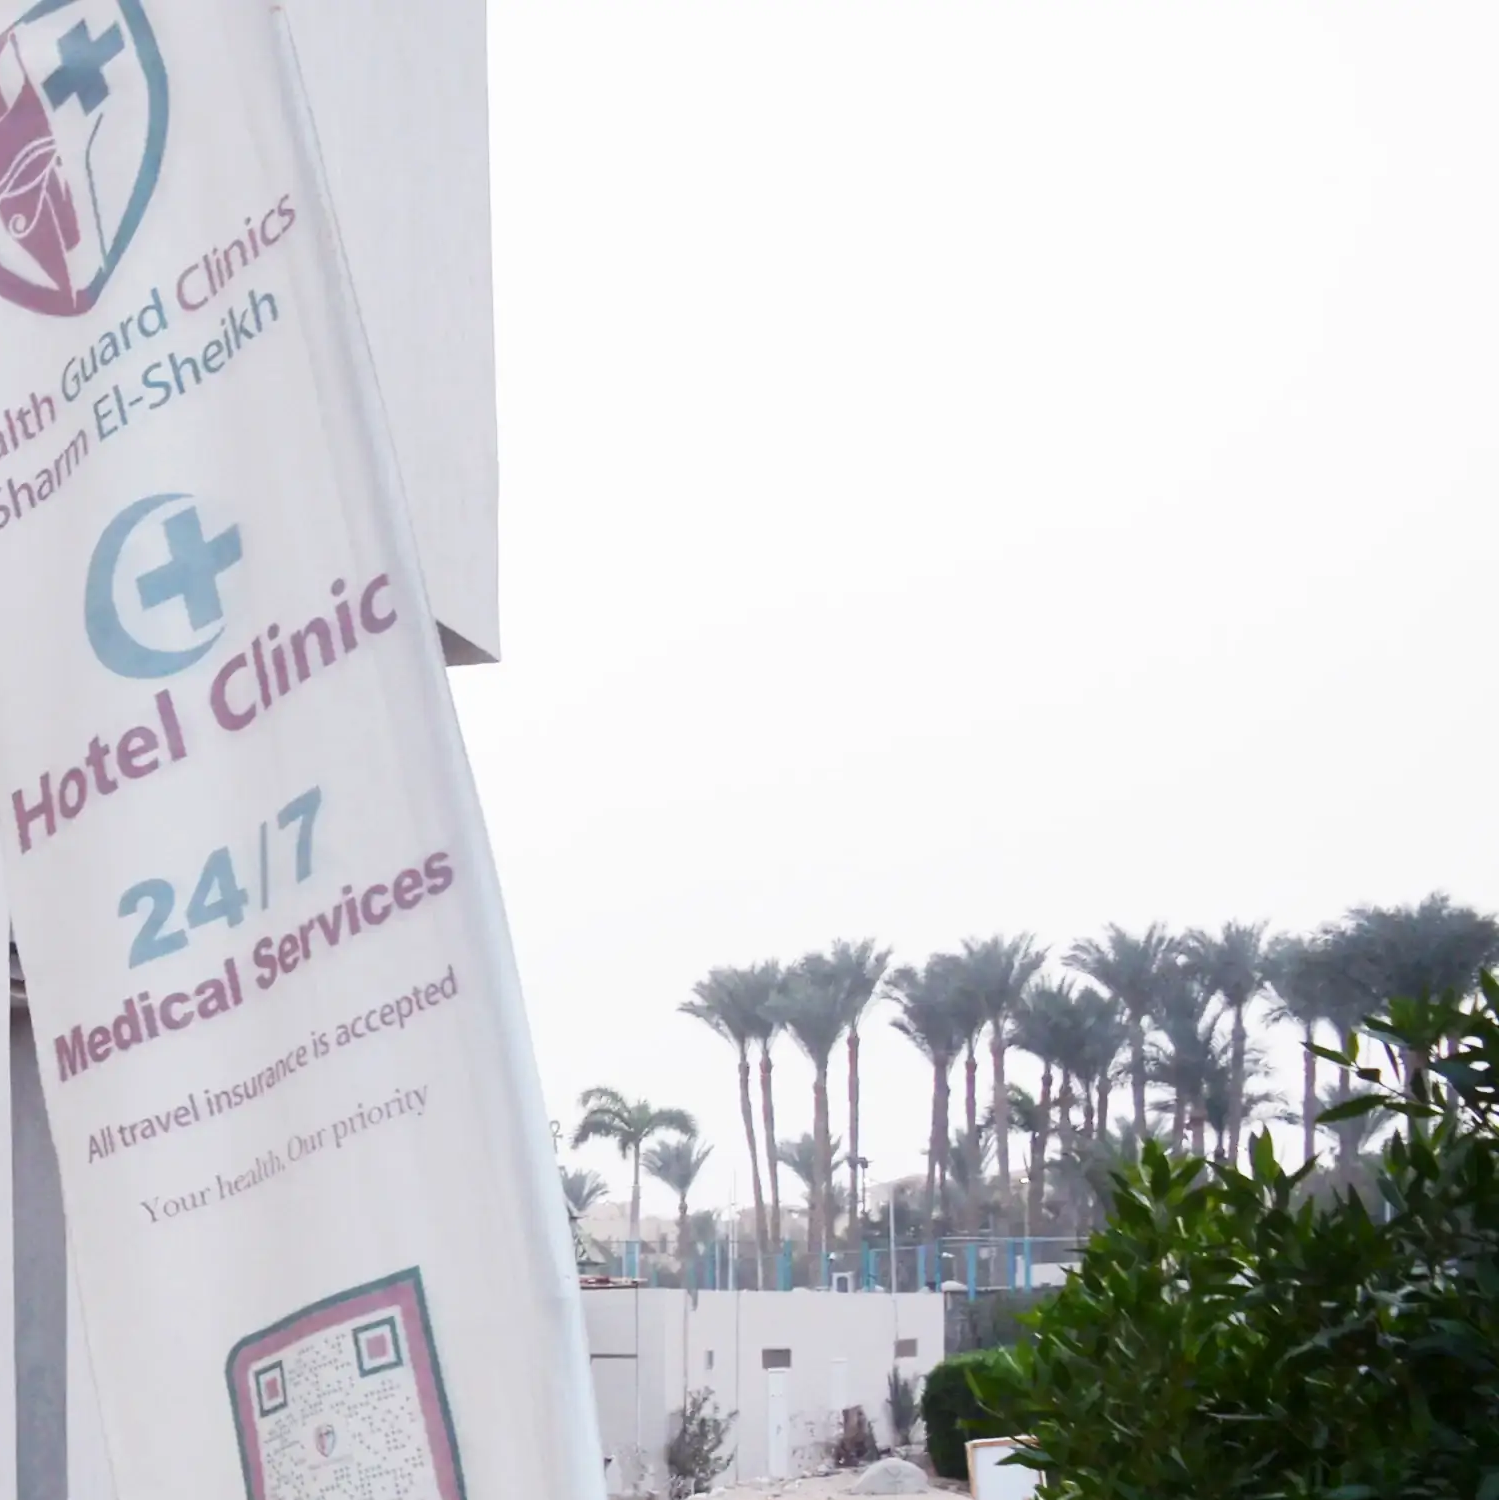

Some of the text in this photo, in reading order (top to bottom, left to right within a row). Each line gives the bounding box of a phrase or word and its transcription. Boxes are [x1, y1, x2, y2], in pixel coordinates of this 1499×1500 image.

[60, 286, 169, 404] Guard
[175, 193, 297, 313] Clinics
[93, 288, 279, 442] El-Sheikh
[11, 572, 399, 852] Hotel Clinic
[53, 851, 456, 1083] Medical Services
[117, 784, 324, 970] 24/7
[87, 964, 459, 1164] All travel insurance is accepted
[140, 1184, 211, 1225] Your
[288, 1125, 328, 1163] Our
[332, 1084, 430, 1150] priority
